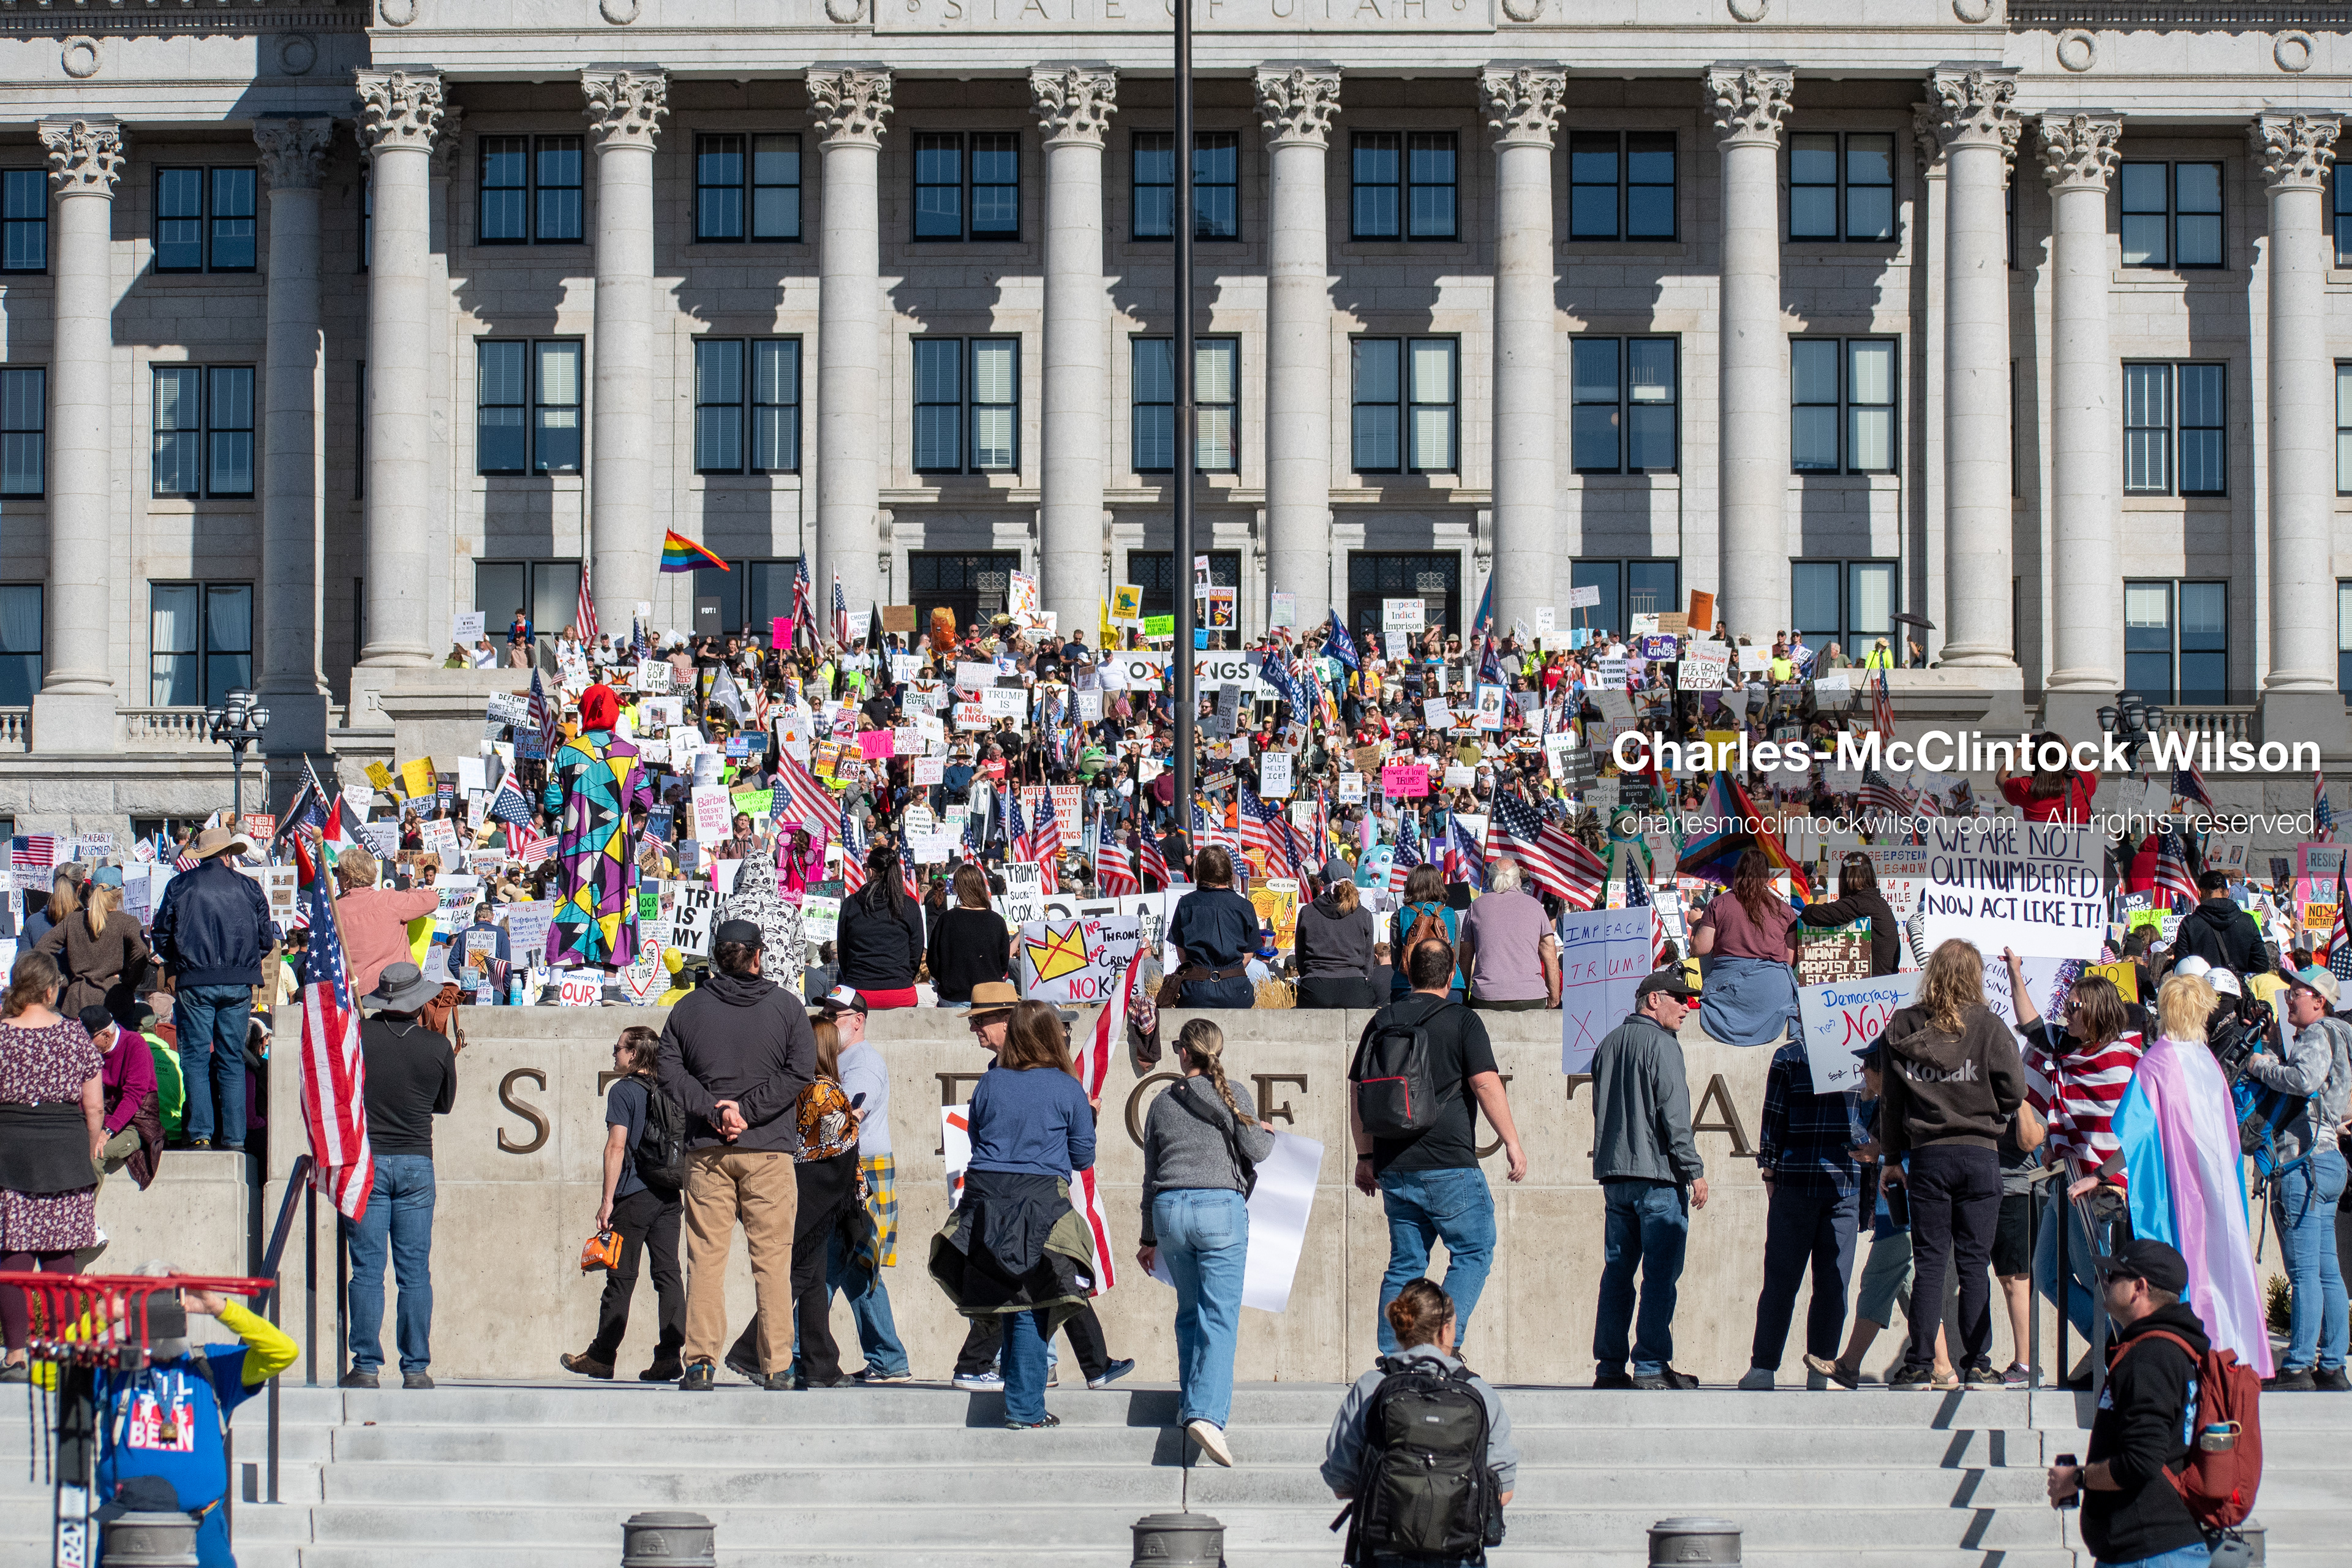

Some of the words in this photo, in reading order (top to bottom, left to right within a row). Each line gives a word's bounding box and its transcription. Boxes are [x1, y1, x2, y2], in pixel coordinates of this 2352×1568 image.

[1387, 601, 1422, 611] Impeach
[1385, 622, 1422, 632] Imprison
[1648, 647, 1676, 658] KINGS
[903, 657, 919, 668] Kings
[646, 680, 668, 689] WTH?
[1679, 677, 1721, 689] FASCISM
[499, 694, 526, 703] DEFEND
[987, 690, 1023, 699] TRUMP
[489, 714, 526, 726] DOMESTIC
[957, 714, 990, 723] KINGS!
[1289, 721, 1306, 731] TRUMP
[736, 758, 747, 766] ICE
[1267, 754, 1287, 763] SALT
[1563, 752, 1589, 761] TYRANNY
[368, 763, 382, 774] NO
[1384, 769, 1403, 778] power
[371, 772, 394, 788] KINGS
[1057, 786, 1079, 795] ELECT
[419, 795, 435, 804] SEEN
[696, 795, 726, 808] Barbie
[1588, 793, 1607, 802] roost
[255, 816, 268, 826] NEED
[268, 817, 273, 826] A
[82, 833, 111, 843] PEACEABLY
[355, 826, 384, 859] FREE
[1936, 826, 1970, 853] WE
[1979, 827, 2019, 855] ARE
[2029, 826, 2089, 858] NOT
[80, 845, 111, 856] ASSEMBLED
[2310, 853, 2343, 867] RESIST
[1006, 863, 1039, 883] TRUMP
[1931, 856, 2098, 899] OUTNUMBERED
[138, 880, 146, 893] OF
[1656, 894, 1675, 903] HATE
[2125, 895, 2143, 905] NO
[1012, 904, 1032, 922] COX
[1659, 903, 1677, 912] WILL
[1928, 894, 1973, 918] NOW
[1980, 897, 2019, 921] ACT
[2023, 900, 2068, 925] LIKE
[2071, 903, 2102, 929] IT!
[2309, 905, 2321, 917] NO
[676, 906, 697, 925] IS
[1084, 921, 1101, 938] NO
[1566, 921, 1646, 940] IMPEACH
[478, 932, 494, 941] KINGS
[672, 928, 703, 949] MY
[1090, 944, 1106, 960] NO
[1804, 948, 1841, 960] WANT
[1849, 946, 1860, 959] A
[1571, 954, 1646, 979] TRUMP
[1799, 961, 1850, 974] RAPIST
[1853, 960, 1869, 973] IS
[1069, 978, 1096, 1000] NO
[1821, 989, 1910, 1008] Democracy
[1906, 1059, 1979, 1082] Kodak
